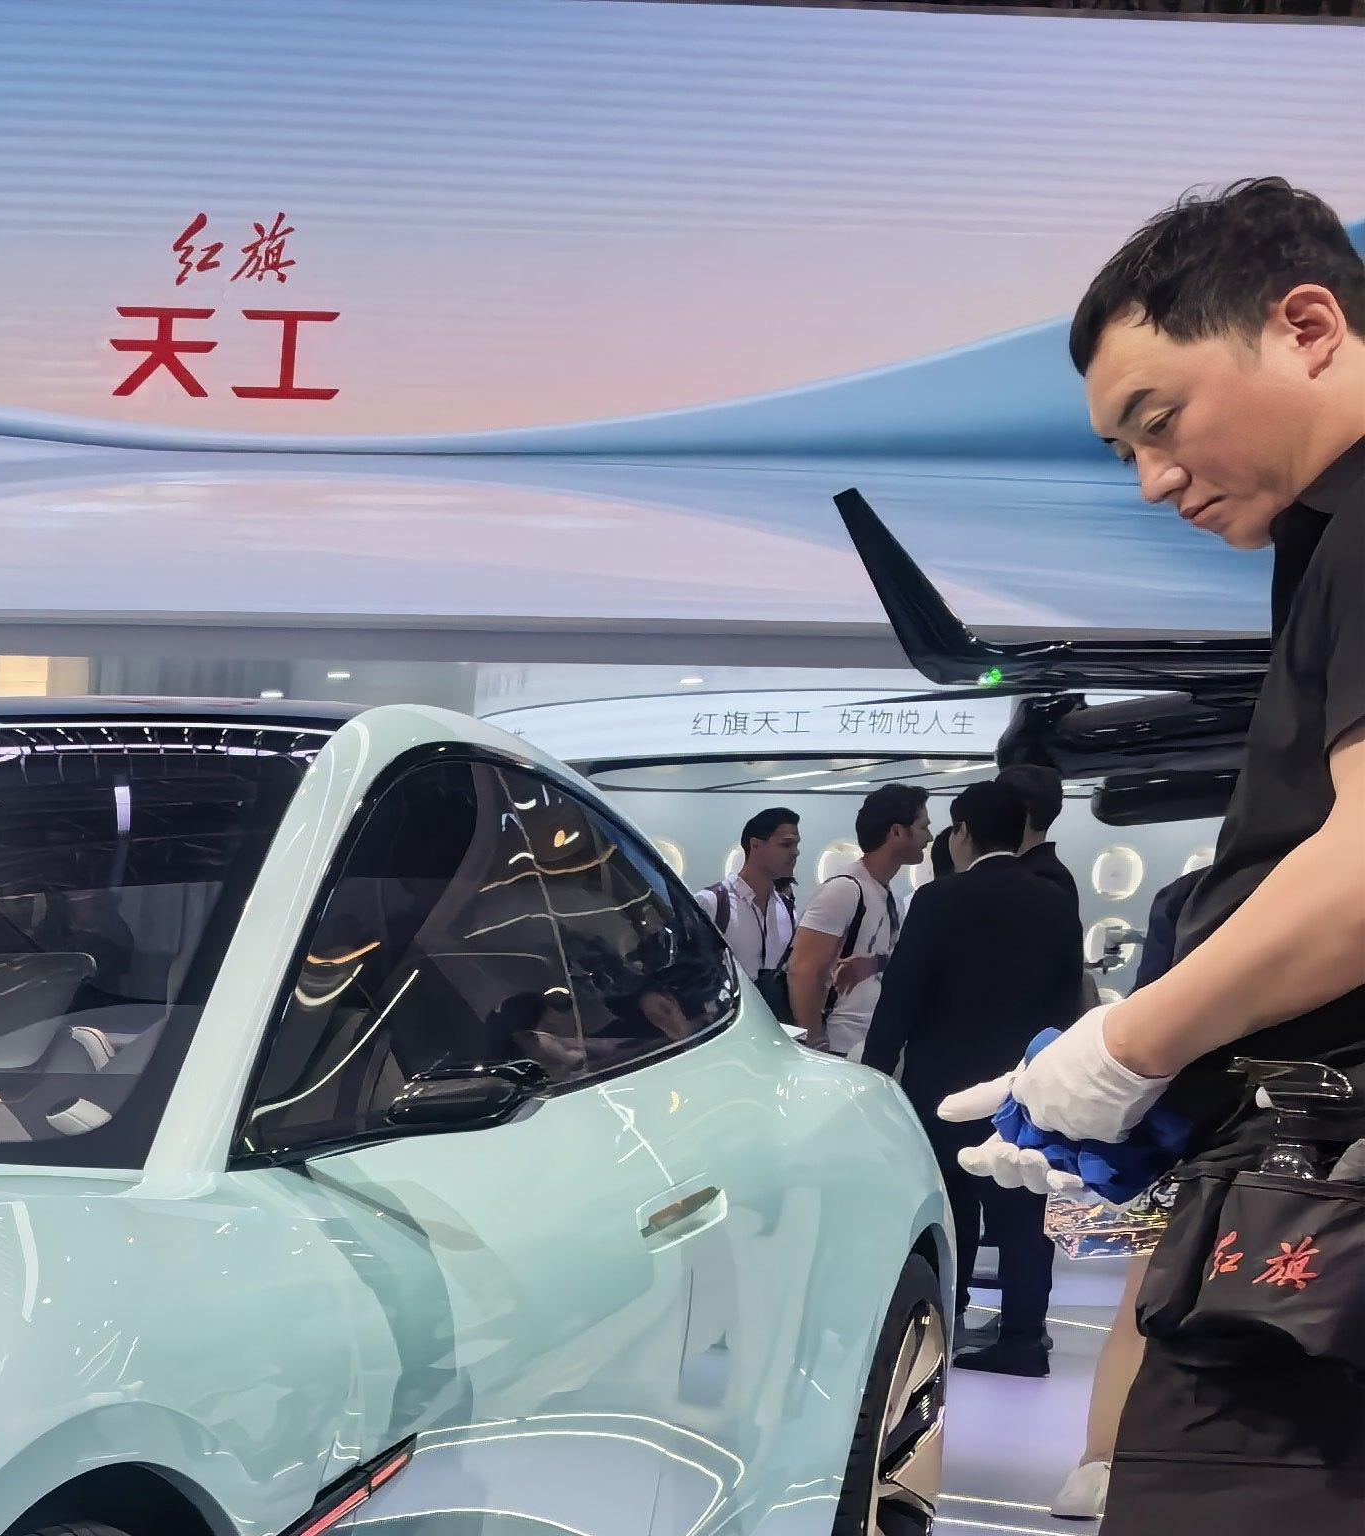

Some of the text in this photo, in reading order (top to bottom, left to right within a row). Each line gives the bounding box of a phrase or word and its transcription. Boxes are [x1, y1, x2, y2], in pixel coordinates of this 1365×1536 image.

[172, 212, 296, 286] 红旗
[109, 306, 341, 400] 天工
[690, 708, 977, 736] 红旗天工 好物悦人生
[1208, 1230, 1320, 1289] 红旗
